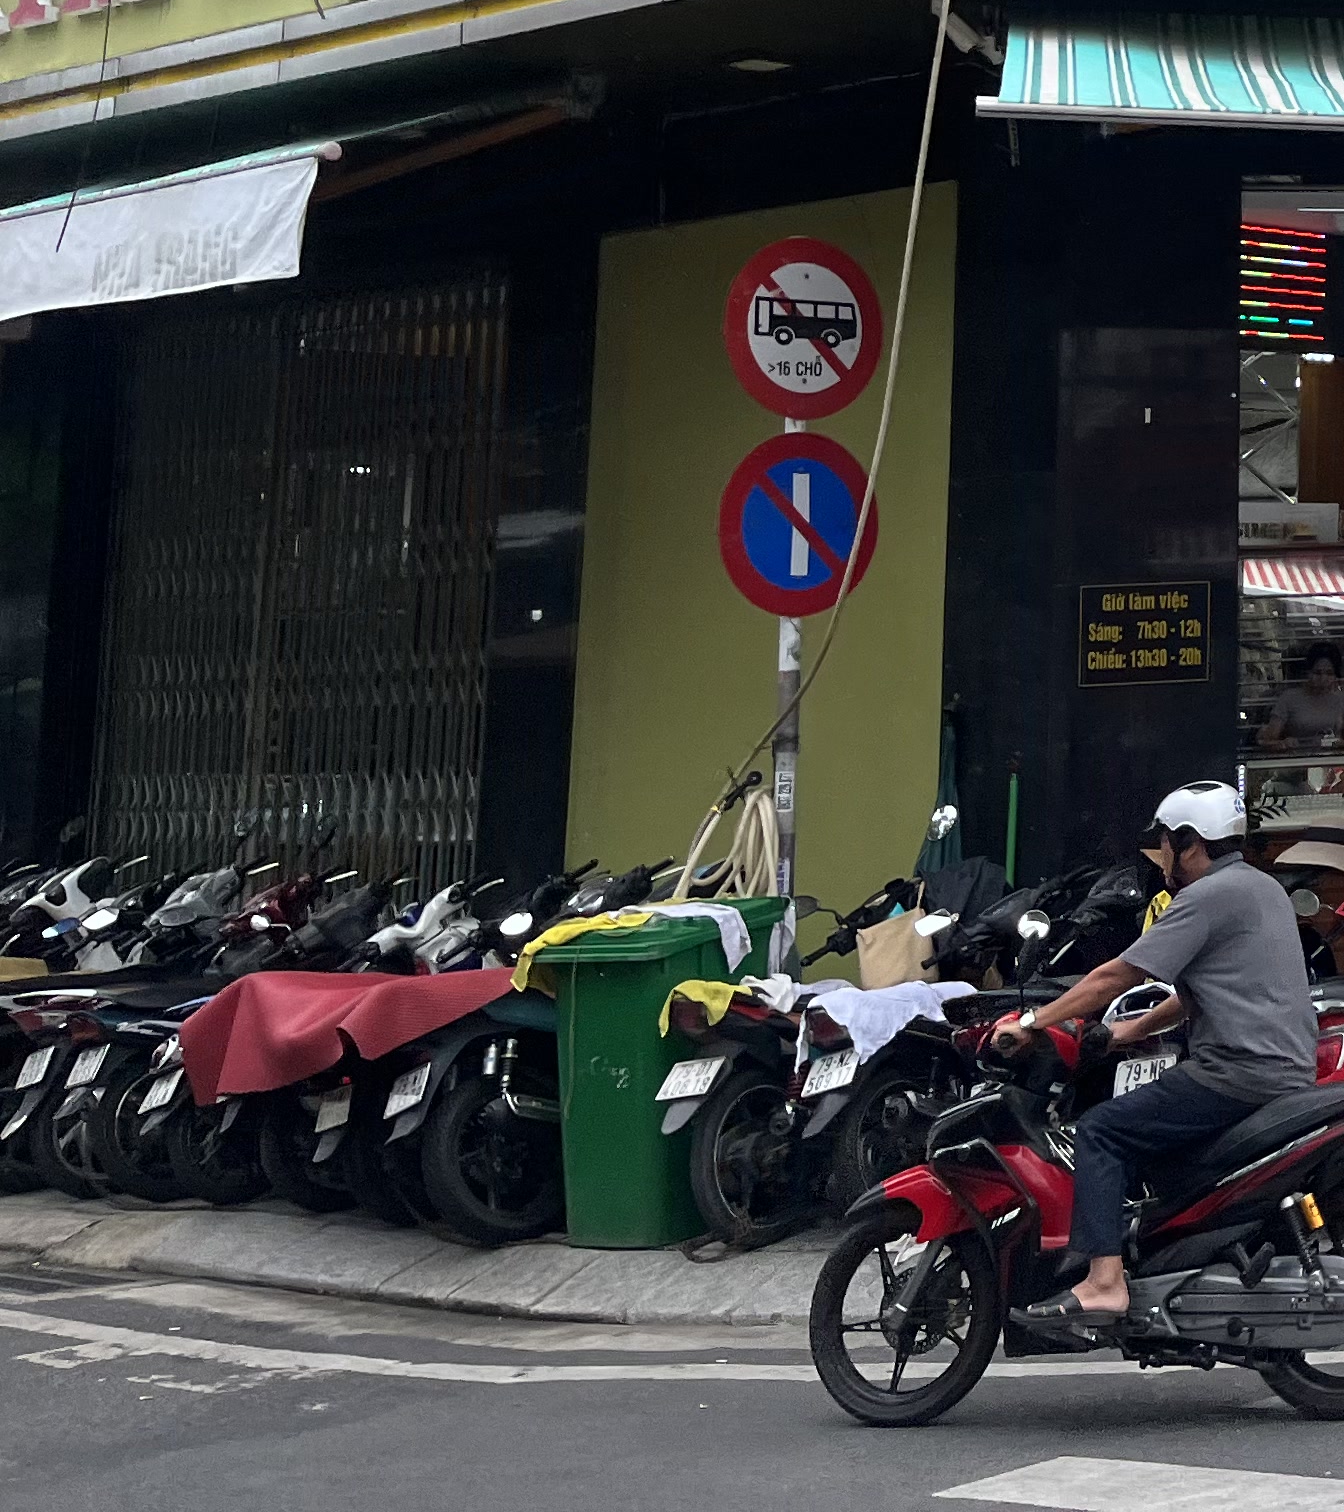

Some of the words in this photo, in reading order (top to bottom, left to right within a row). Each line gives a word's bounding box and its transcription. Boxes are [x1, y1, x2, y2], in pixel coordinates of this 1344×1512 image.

[1101, 592, 1125, 612] Giờ
[1128, 593, 1155, 611] làm
[1159, 590, 1189, 614] việc
[1088, 622, 1123, 643] Sáng:
[1137, 620, 1167, 639] 7h30
[1180, 619, 1202, 638] 12h
[1087, 648, 1127, 671] Chiều:
[1130, 648, 1167, 669] 13h30
[1178, 647, 1202, 666] 20h
